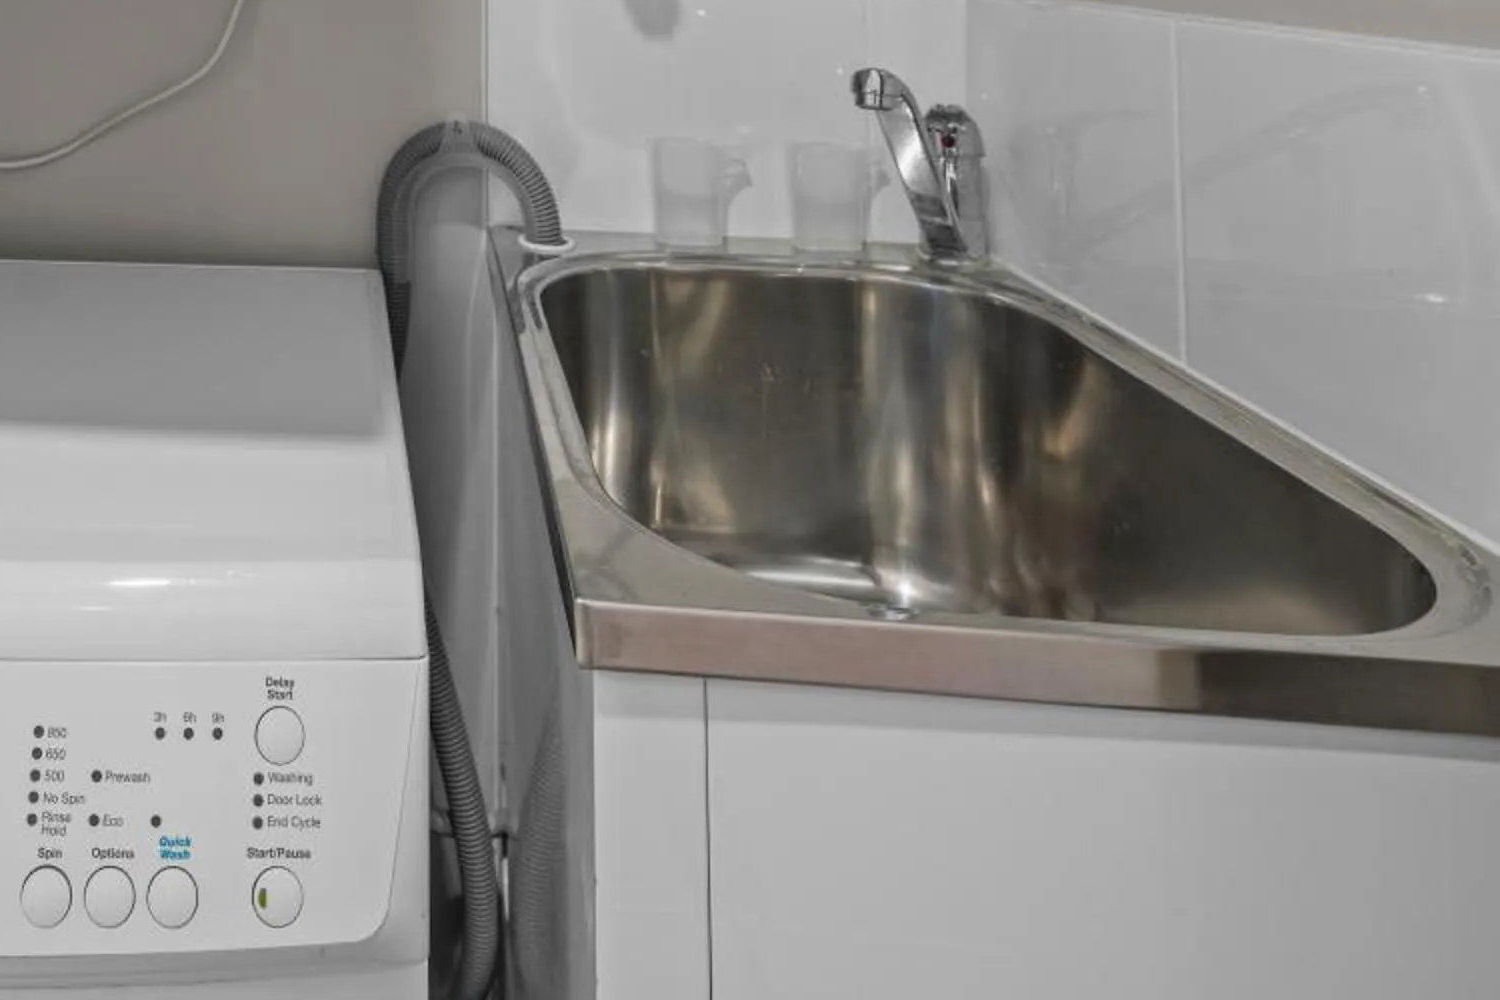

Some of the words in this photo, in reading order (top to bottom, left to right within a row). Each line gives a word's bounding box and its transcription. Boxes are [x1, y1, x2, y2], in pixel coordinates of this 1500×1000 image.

[265, 677, 295, 689] Delay
[266, 689, 293, 700] Start
[105, 770, 151, 783] Prewash
[267, 772, 313, 786] Washing
[43, 791, 59, 804] No
[61, 792, 86, 805] Spin
[267, 793, 293, 805] Door
[296, 793, 322, 805] Lock
[41, 811, 71, 823] Rinse
[267, 816, 288, 828] End
[291, 816, 321, 831] Cycle
[159, 835, 192, 847] Quick
[37, 847, 63, 860] Spin
[91, 847, 135, 861] Options
[160, 849, 191, 860] Wash
[246, 847, 312, 860] Start/Pause
